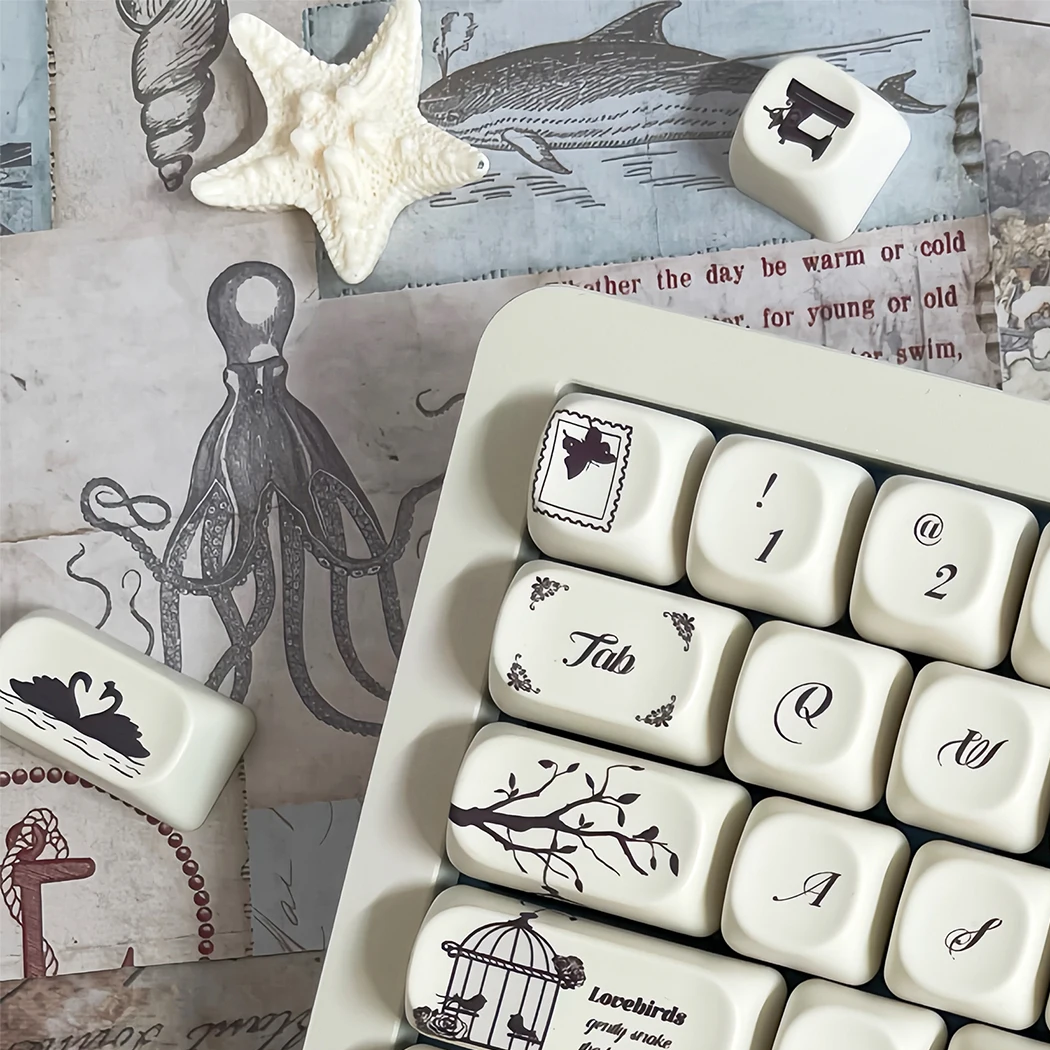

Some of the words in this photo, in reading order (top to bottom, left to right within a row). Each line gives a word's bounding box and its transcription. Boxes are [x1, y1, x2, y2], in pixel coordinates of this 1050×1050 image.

[657, 267, 692, 291] the
[706, 262, 745, 285] day
[761, 257, 787, 278] be
[802, 246, 865, 272] warm
[881, 241, 905, 262] or
[920, 230, 966, 257] cold
[763, 307, 795, 329] for
[807, 298, 876, 327] young
[887, 295, 912, 313] or
[924, 285, 958, 308] old
[755, 530, 783, 563] 1
[914, 514, 943, 546] @
[924, 564, 957, 599] 2
[563, 631, 635, 674] Tab
[774, 682, 832, 744] Q
[773, 872, 841, 907] A
[588, 986, 687, 1026] Lovebirds
